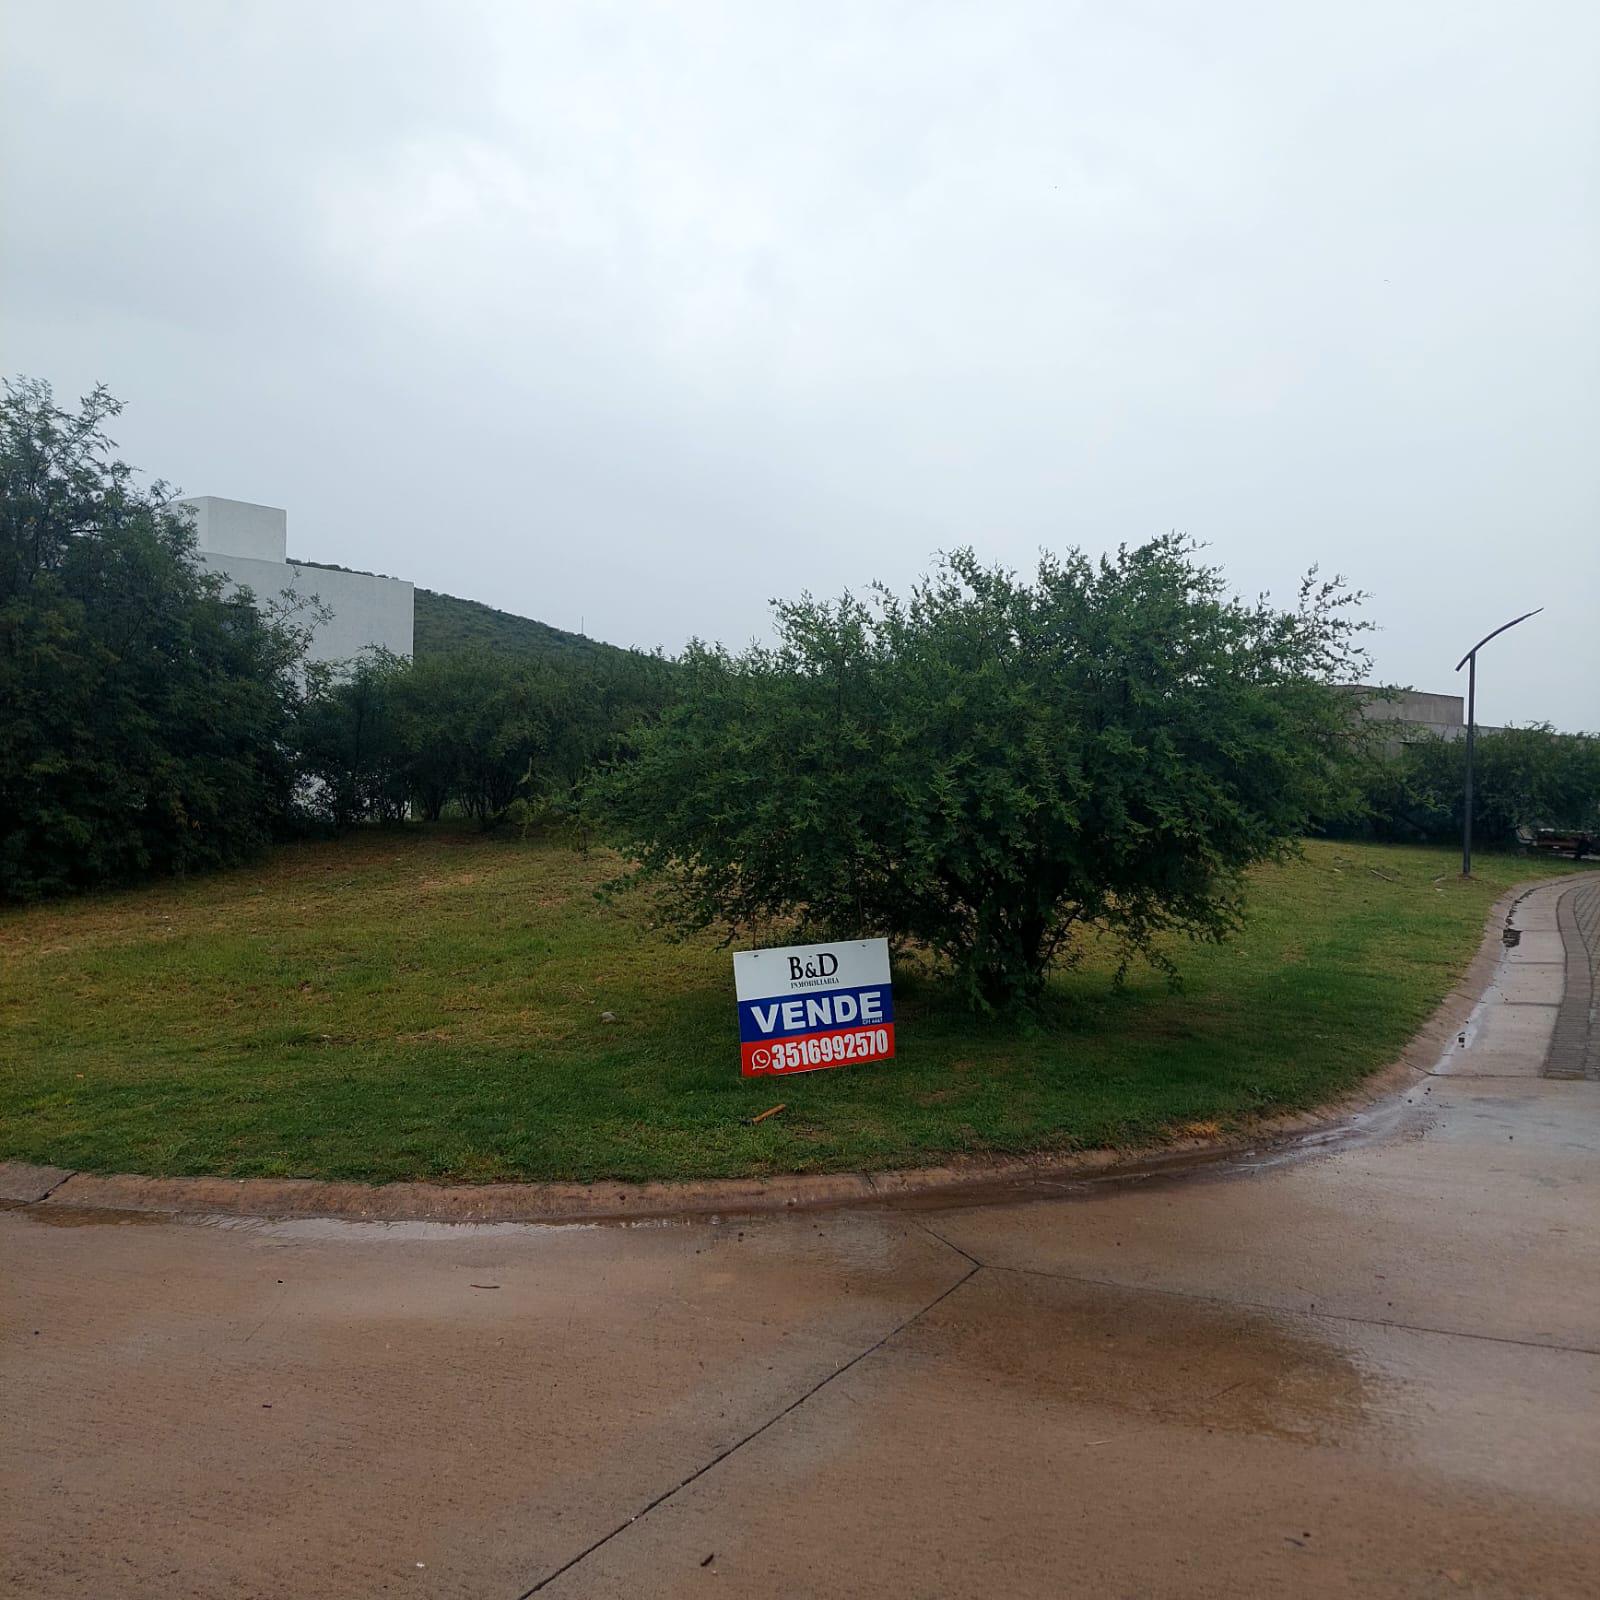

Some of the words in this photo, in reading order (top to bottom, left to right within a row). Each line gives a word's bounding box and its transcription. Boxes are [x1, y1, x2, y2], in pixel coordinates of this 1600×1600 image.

[787, 953, 838, 980] B&D
[791, 977, 839, 988] INMOBILIARIA
[750, 991, 883, 1033] VENDE
[771, 1029, 889, 1069] 3516992570
